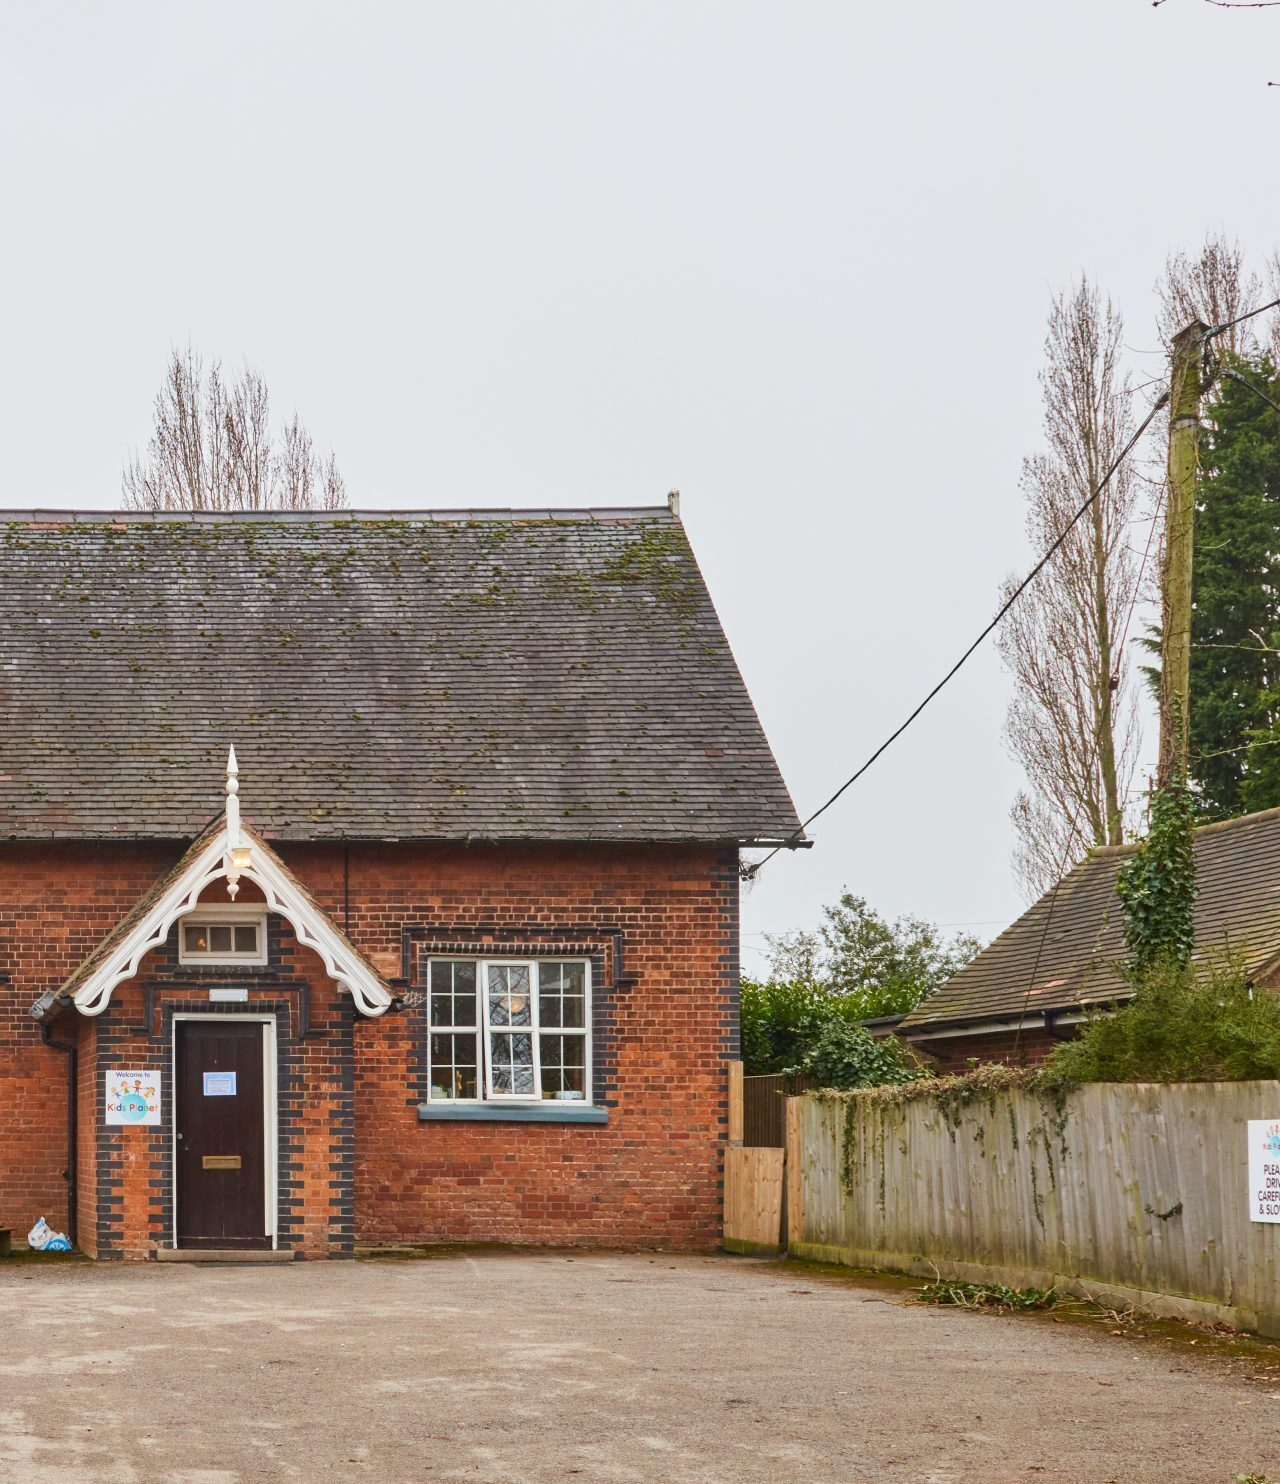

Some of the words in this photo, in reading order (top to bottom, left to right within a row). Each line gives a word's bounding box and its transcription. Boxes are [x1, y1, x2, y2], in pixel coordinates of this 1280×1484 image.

[107, 1103, 127, 1112] Kids
[129, 1103, 159, 1112] Planet
[1264, 1164, 1280, 1175] PLEA
[1258, 1191, 1280, 1201] CAREF
[1259, 1204, 1265, 1215] &
[1266, 1204, 1280, 1215] SLO
